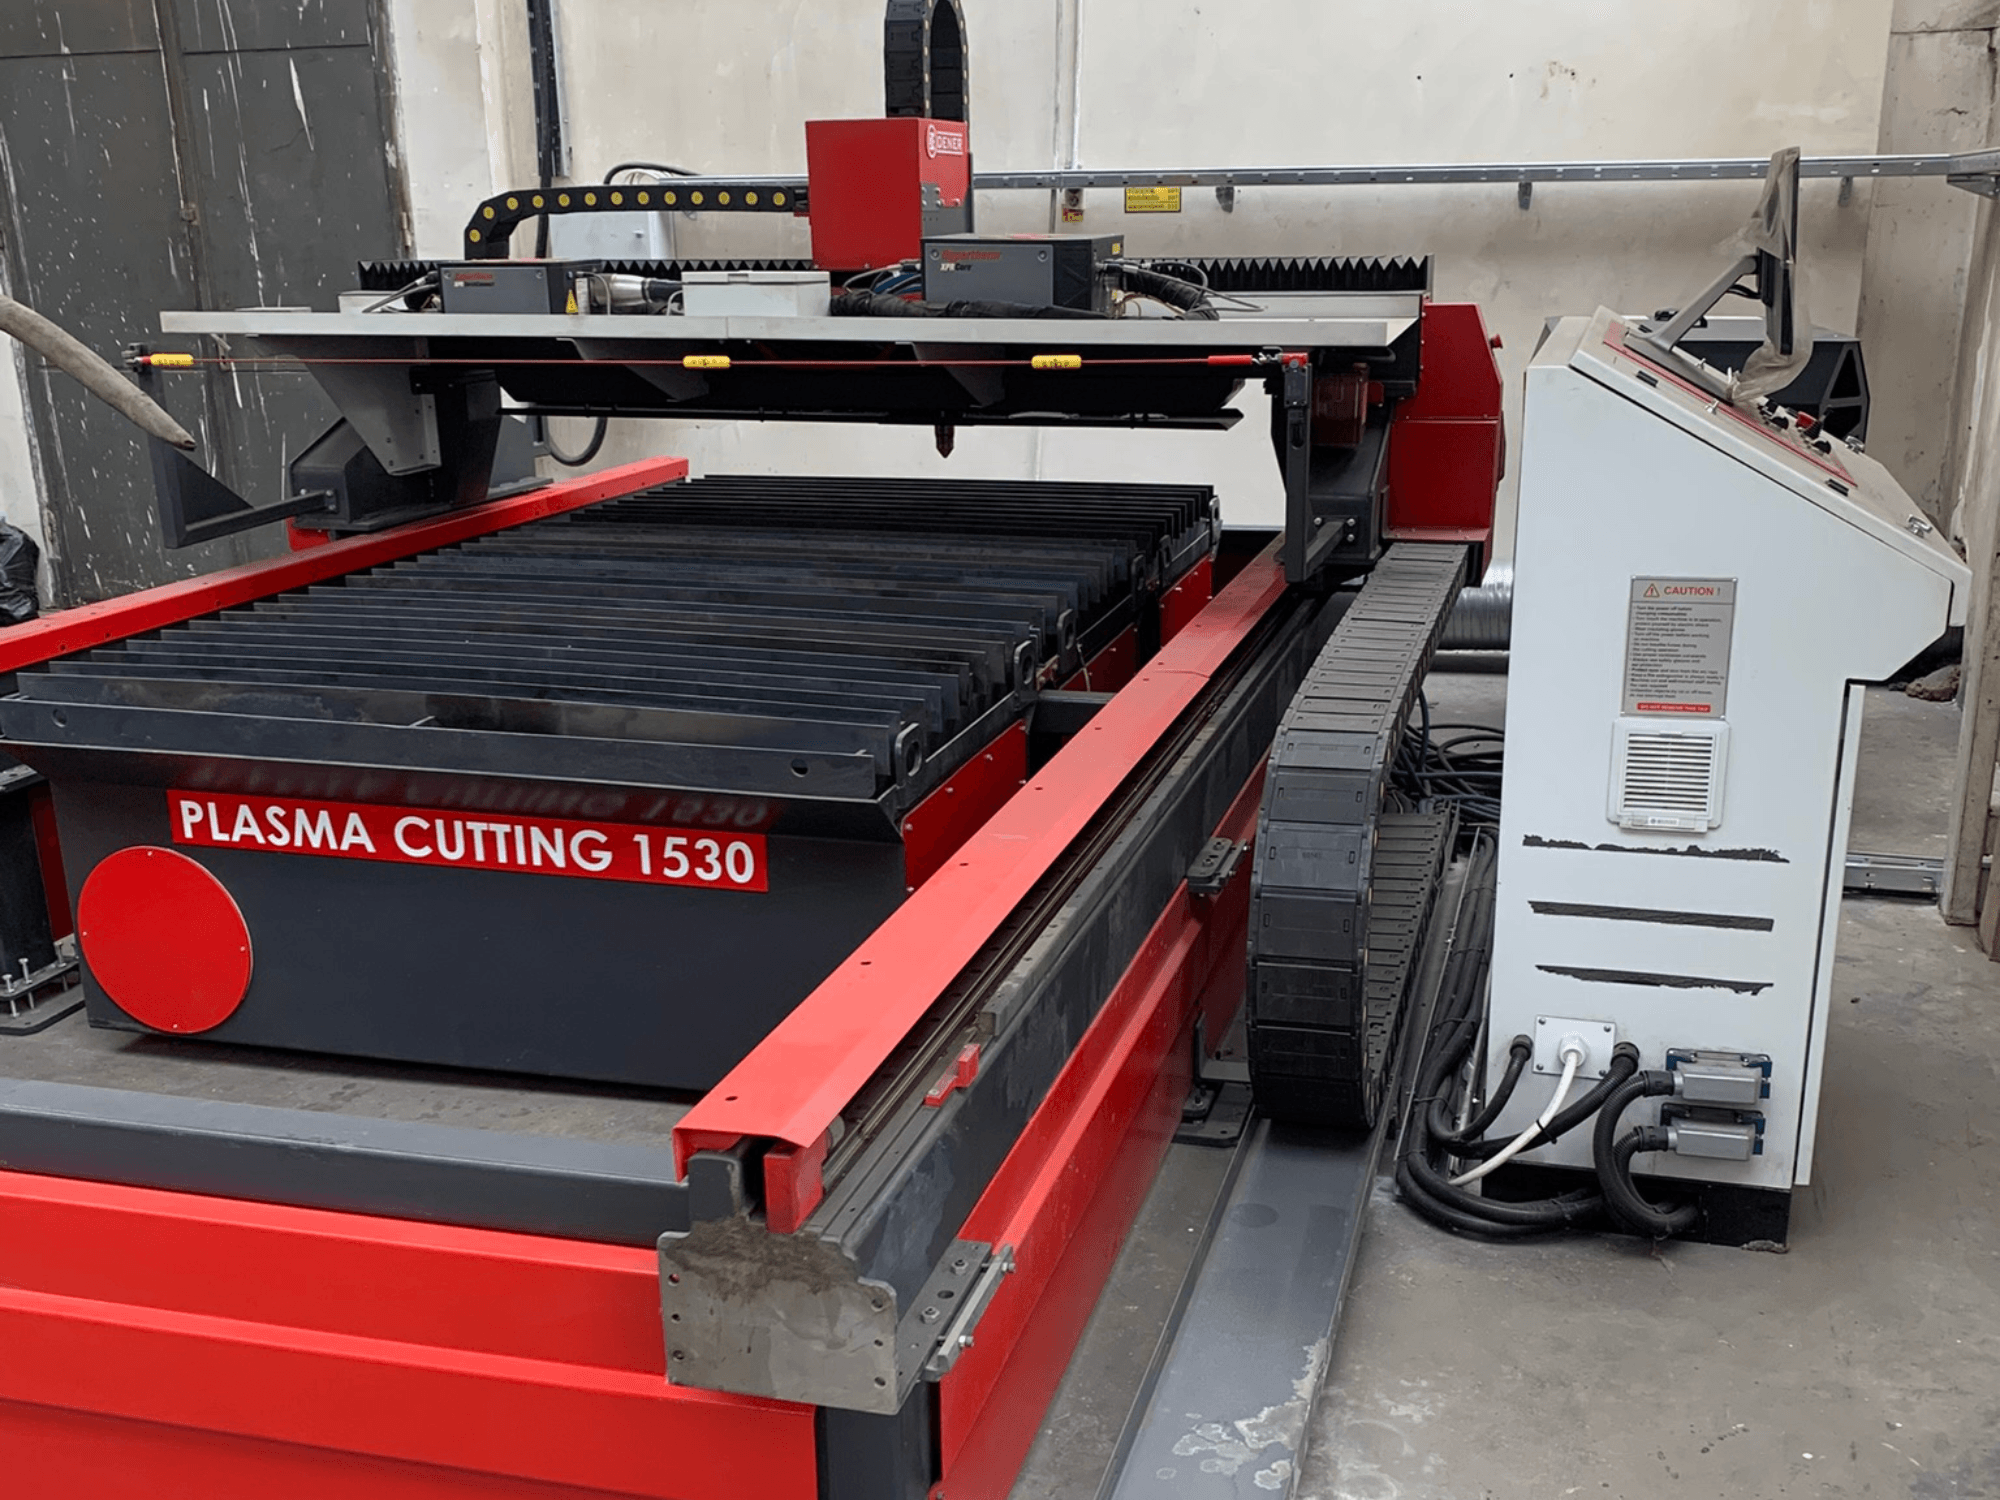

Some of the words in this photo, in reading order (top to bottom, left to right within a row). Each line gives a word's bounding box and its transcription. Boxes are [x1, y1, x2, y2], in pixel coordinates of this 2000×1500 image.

[937, 136, 961, 150] DENER
[1664, 586, 1715, 596] CAUTION
[181, 801, 376, 852] PLASMA
[395, 817, 612, 871] CUTTING
[634, 835, 755, 882] 1530
